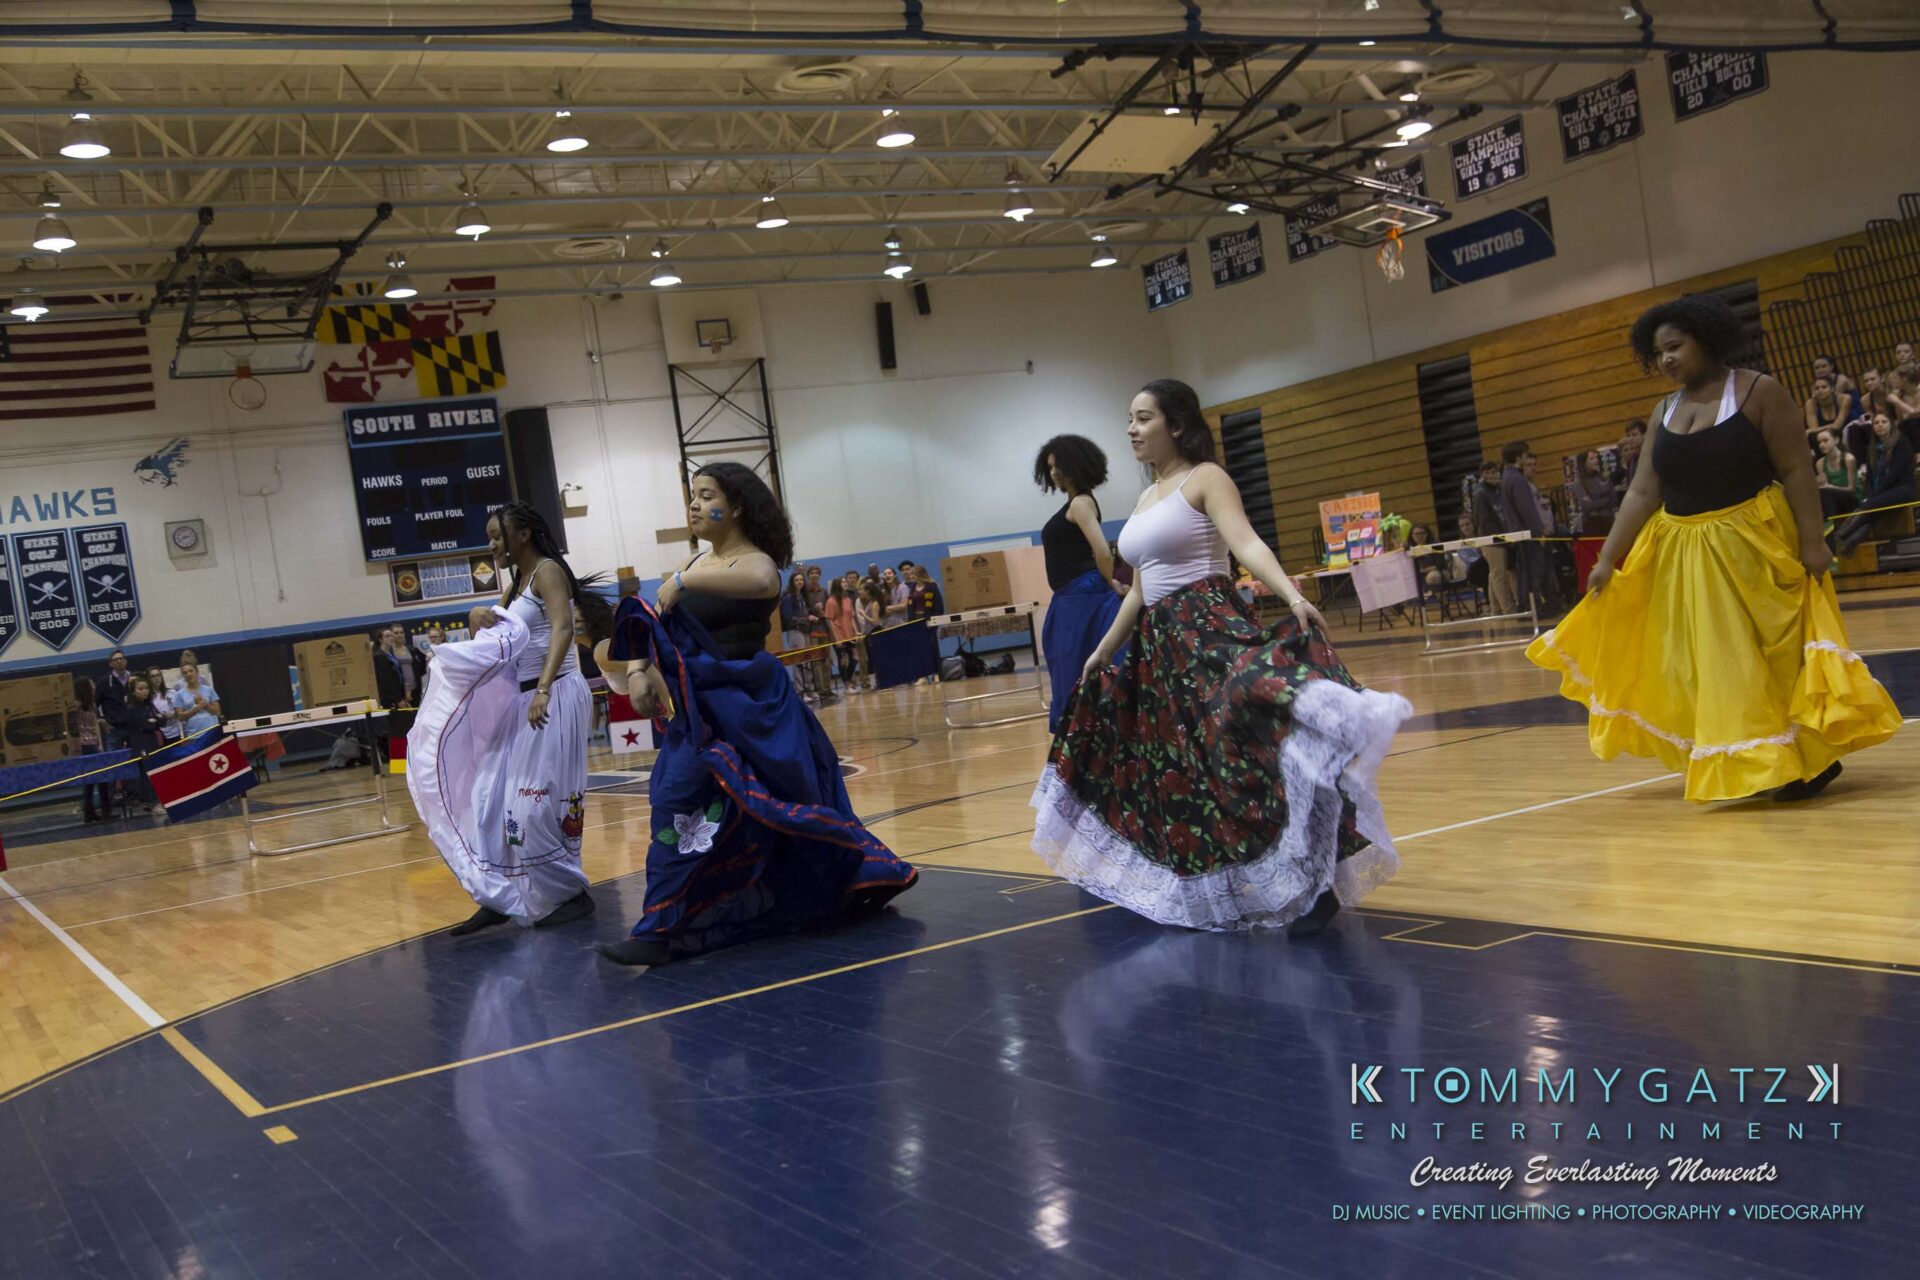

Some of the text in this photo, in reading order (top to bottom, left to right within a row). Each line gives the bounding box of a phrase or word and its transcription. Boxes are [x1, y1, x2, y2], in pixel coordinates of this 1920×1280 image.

[1672, 52, 1751, 84] CHAMPIO
[1679, 75, 1708, 97] FIELD
[1715, 55, 1756, 84] HOCKEY
[1577, 82, 1620, 108] STATE
[1687, 74, 1752, 110] 20 00
[1562, 89, 1638, 128] CHAMPIONS
[1603, 104, 1637, 127] SOCCER
[1467, 126, 1506, 152] STATE
[1578, 122, 1631, 151] 19 97
[1454, 133, 1522, 169] CHAMPIONS
[1490, 147, 1521, 170] SOCCER
[1468, 164, 1516, 193] 19 96
[1211, 238, 1260, 261] CHAMPIONS
[1220, 233, 1248, 248] STATE
[1452, 228, 1525, 266] VISITORS
[1145, 264, 1188, 286] CHAMPIONS
[1154, 255, 1179, 273] STATE
[1221, 269, 1229, 281] 19
[352, 408, 495, 435] SOUTH RIVER
[362, 464, 501, 489] HAWKS PERIOD GUEST
[0, 487, 117, 524] AWKS
[366, 516, 391, 527] FOULS
[415, 510, 444, 521] PLAYER
[445, 508, 464, 518] FOUL
[23, 536, 58, 549] STATE
[82, 530, 117, 543] STATE
[28, 549, 57, 561] GOLF
[88, 543, 116, 554] GOLF
[371, 540, 457, 558] SCORE MATCH
[22, 560, 70, 578] CHAMPION
[81, 553, 128, 572] CHAMPION
[30, 607, 77, 621] JOSH EURE
[89, 599, 135, 614] JOSH EURE
[39, 618, 70, 630] 2006
